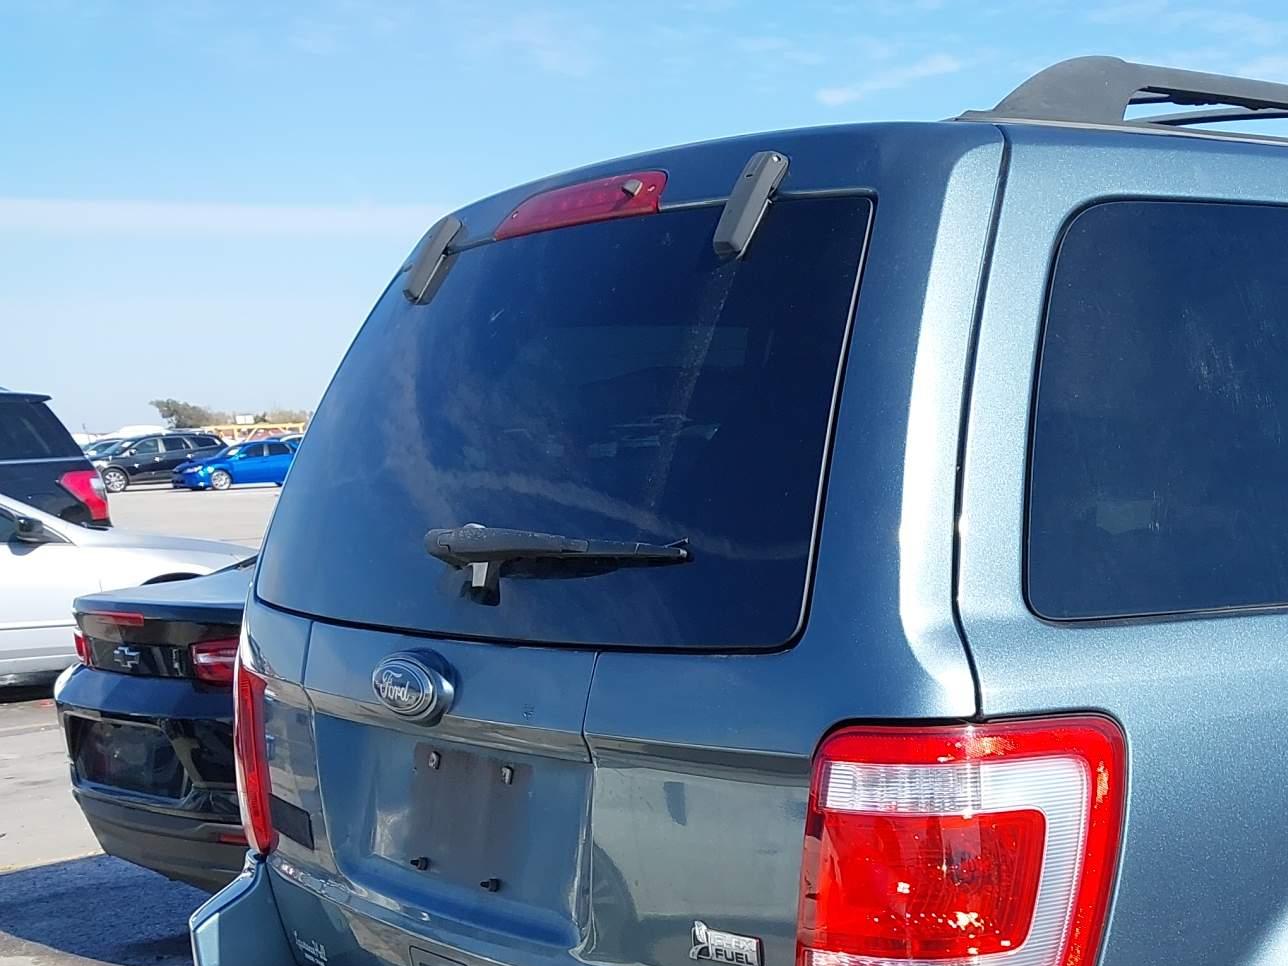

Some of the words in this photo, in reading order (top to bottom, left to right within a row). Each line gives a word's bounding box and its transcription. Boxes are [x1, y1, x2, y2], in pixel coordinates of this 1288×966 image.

[376, 669, 412, 702] Ford
[713, 935, 754, 952] FLEX
[714, 948, 754, 966] FUEL
